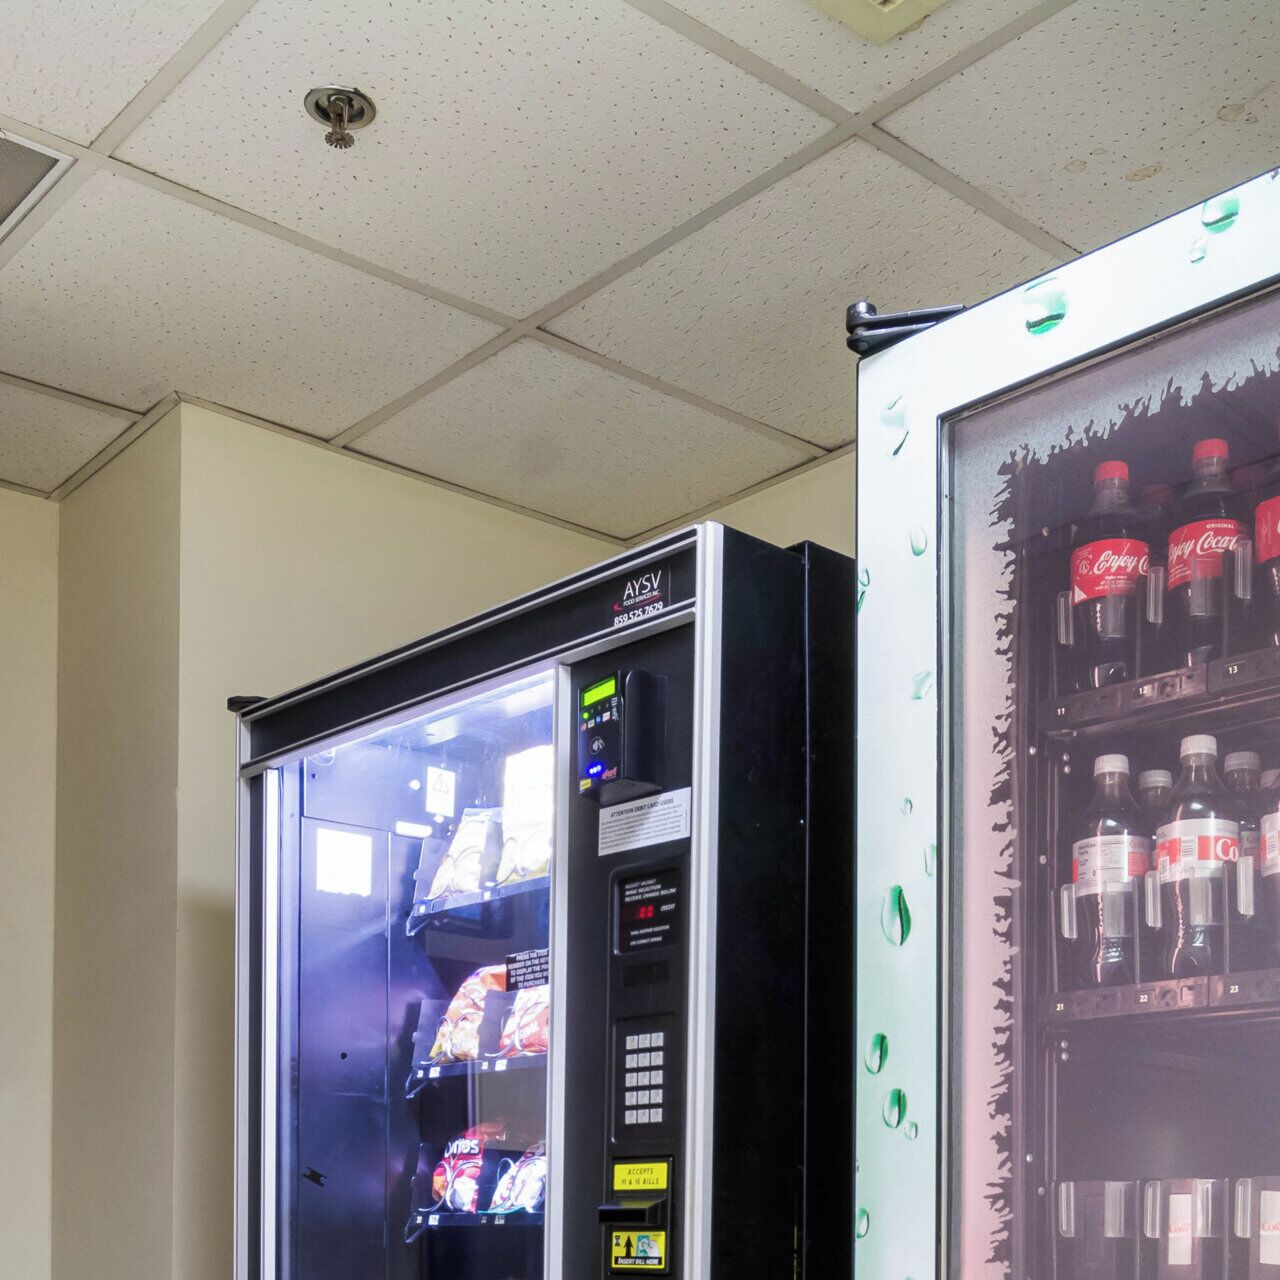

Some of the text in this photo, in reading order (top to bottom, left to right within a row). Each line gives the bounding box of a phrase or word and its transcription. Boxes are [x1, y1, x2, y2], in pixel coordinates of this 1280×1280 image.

[1093, 550, 1138, 576] Enjoy
[623, 569, 663, 601] AYSV
[613, 600, 664, 628] 859.525.7629
[1228, 665, 1238, 674] 13
[1229, 984, 1239, 994] 23
[1139, 994, 1148, 1003] 22
[627, 1167, 654, 1176] ACCEPTS
[617, 1256, 636, 1266] INSERT
